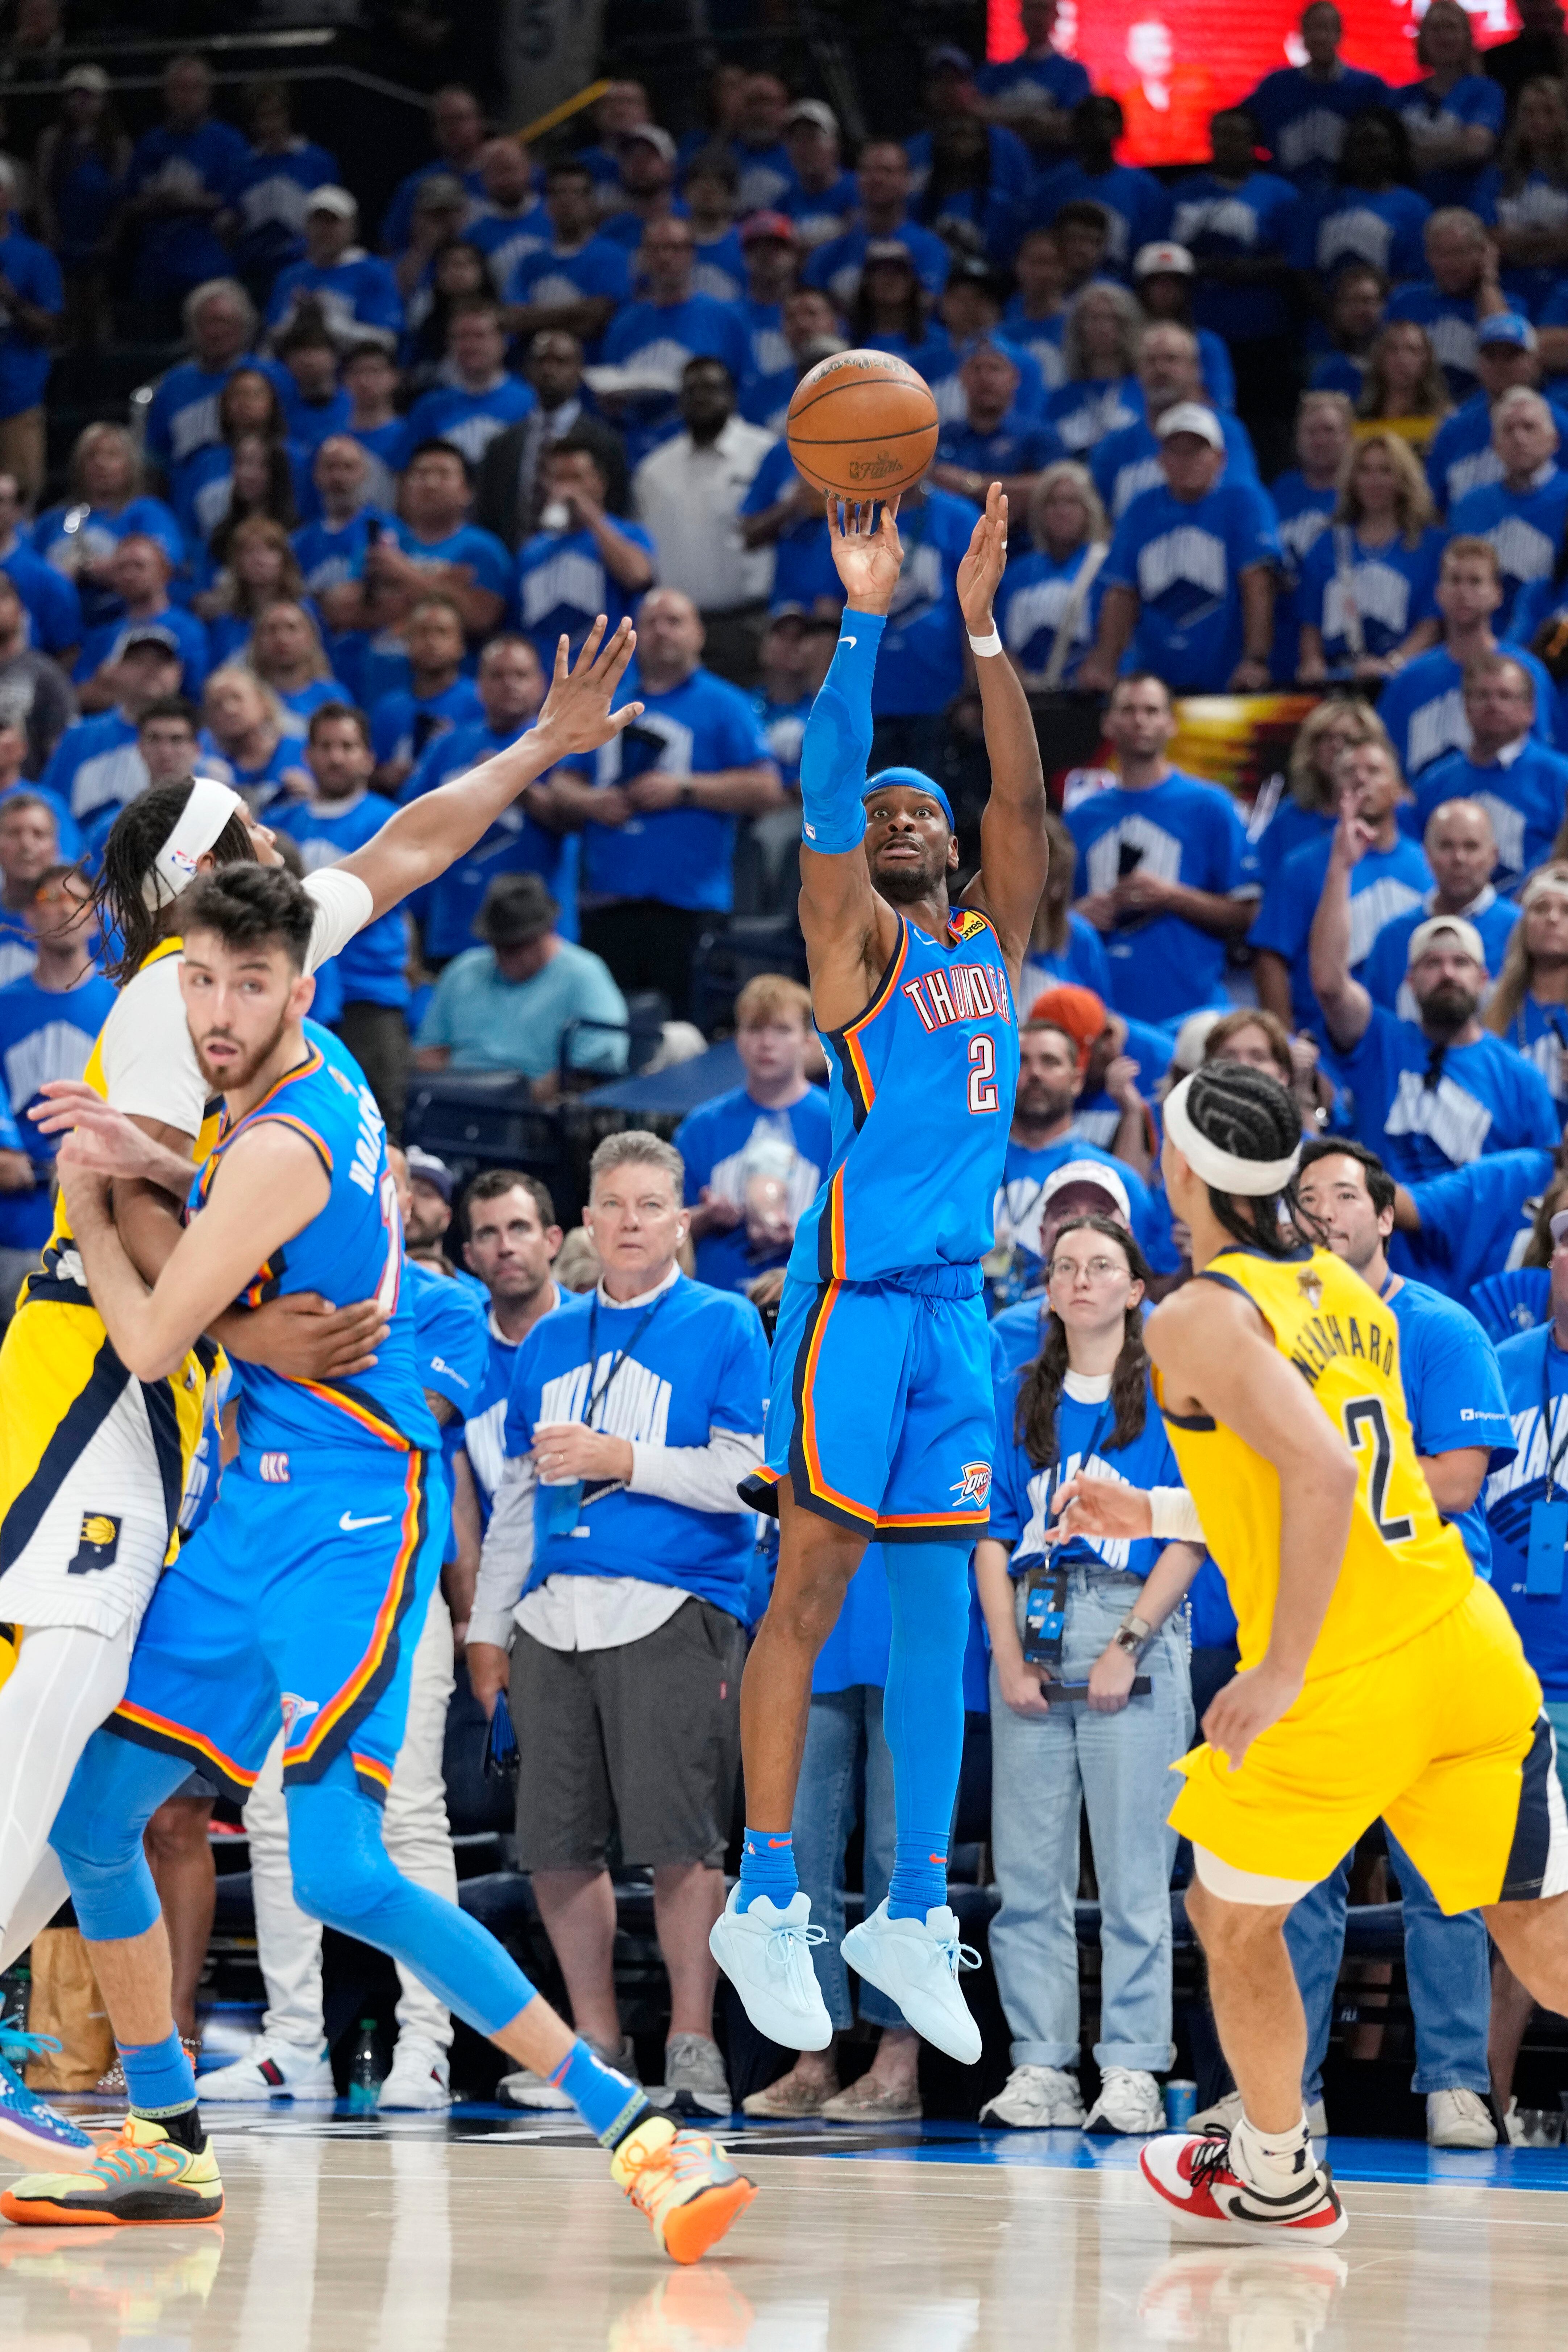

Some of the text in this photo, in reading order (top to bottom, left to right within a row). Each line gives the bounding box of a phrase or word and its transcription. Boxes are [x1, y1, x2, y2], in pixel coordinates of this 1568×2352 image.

[901, 963, 1011, 1034] THUNDER
[968, 1034, 999, 1115] 2
[963, 1471, 989, 1496] OKC
[1343, 1395, 1416, 1543] 2
